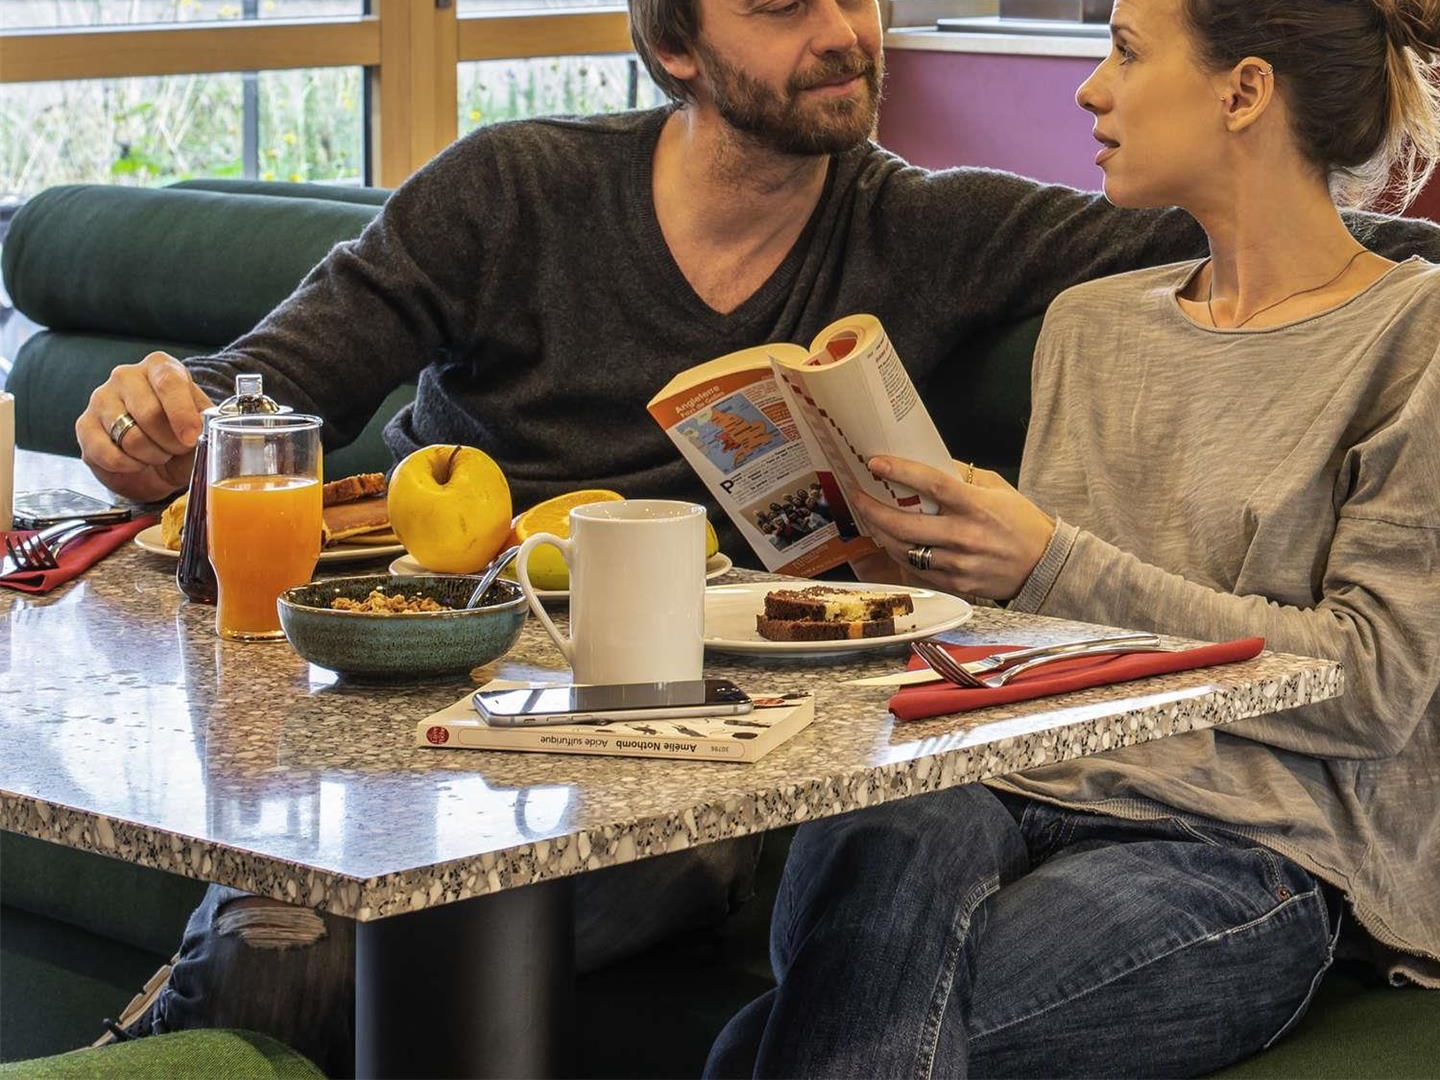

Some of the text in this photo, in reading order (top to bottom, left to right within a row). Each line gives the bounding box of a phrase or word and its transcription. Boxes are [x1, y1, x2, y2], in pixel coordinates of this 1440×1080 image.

[540, 735, 583, 748] sulfurique
[584, 737, 609, 748] Acide
[615, 739, 661, 751] Nothomb
[663, 741, 697, 753] Amélie
